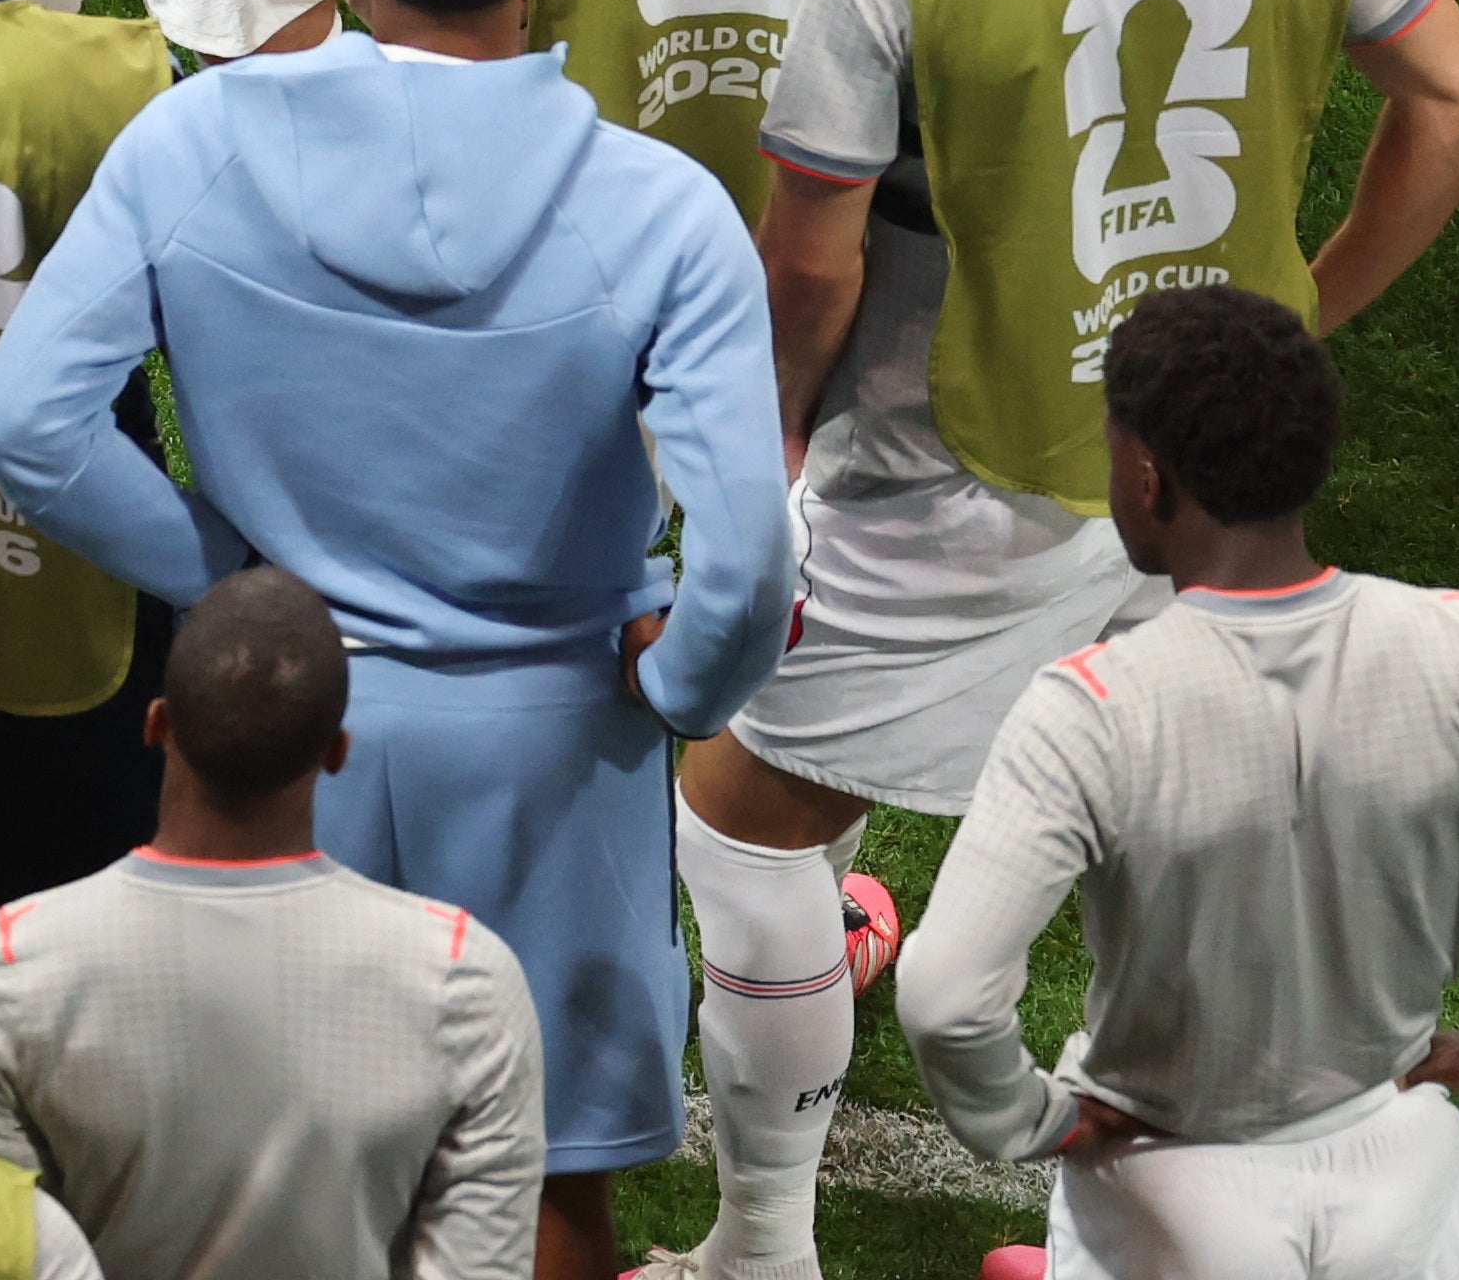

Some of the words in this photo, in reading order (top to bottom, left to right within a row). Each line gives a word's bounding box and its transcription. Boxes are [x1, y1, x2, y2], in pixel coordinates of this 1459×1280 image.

[637, 26, 739, 79] WORLD
[745, 28, 789, 61] CU
[1099, 196, 1176, 245] FIFA
